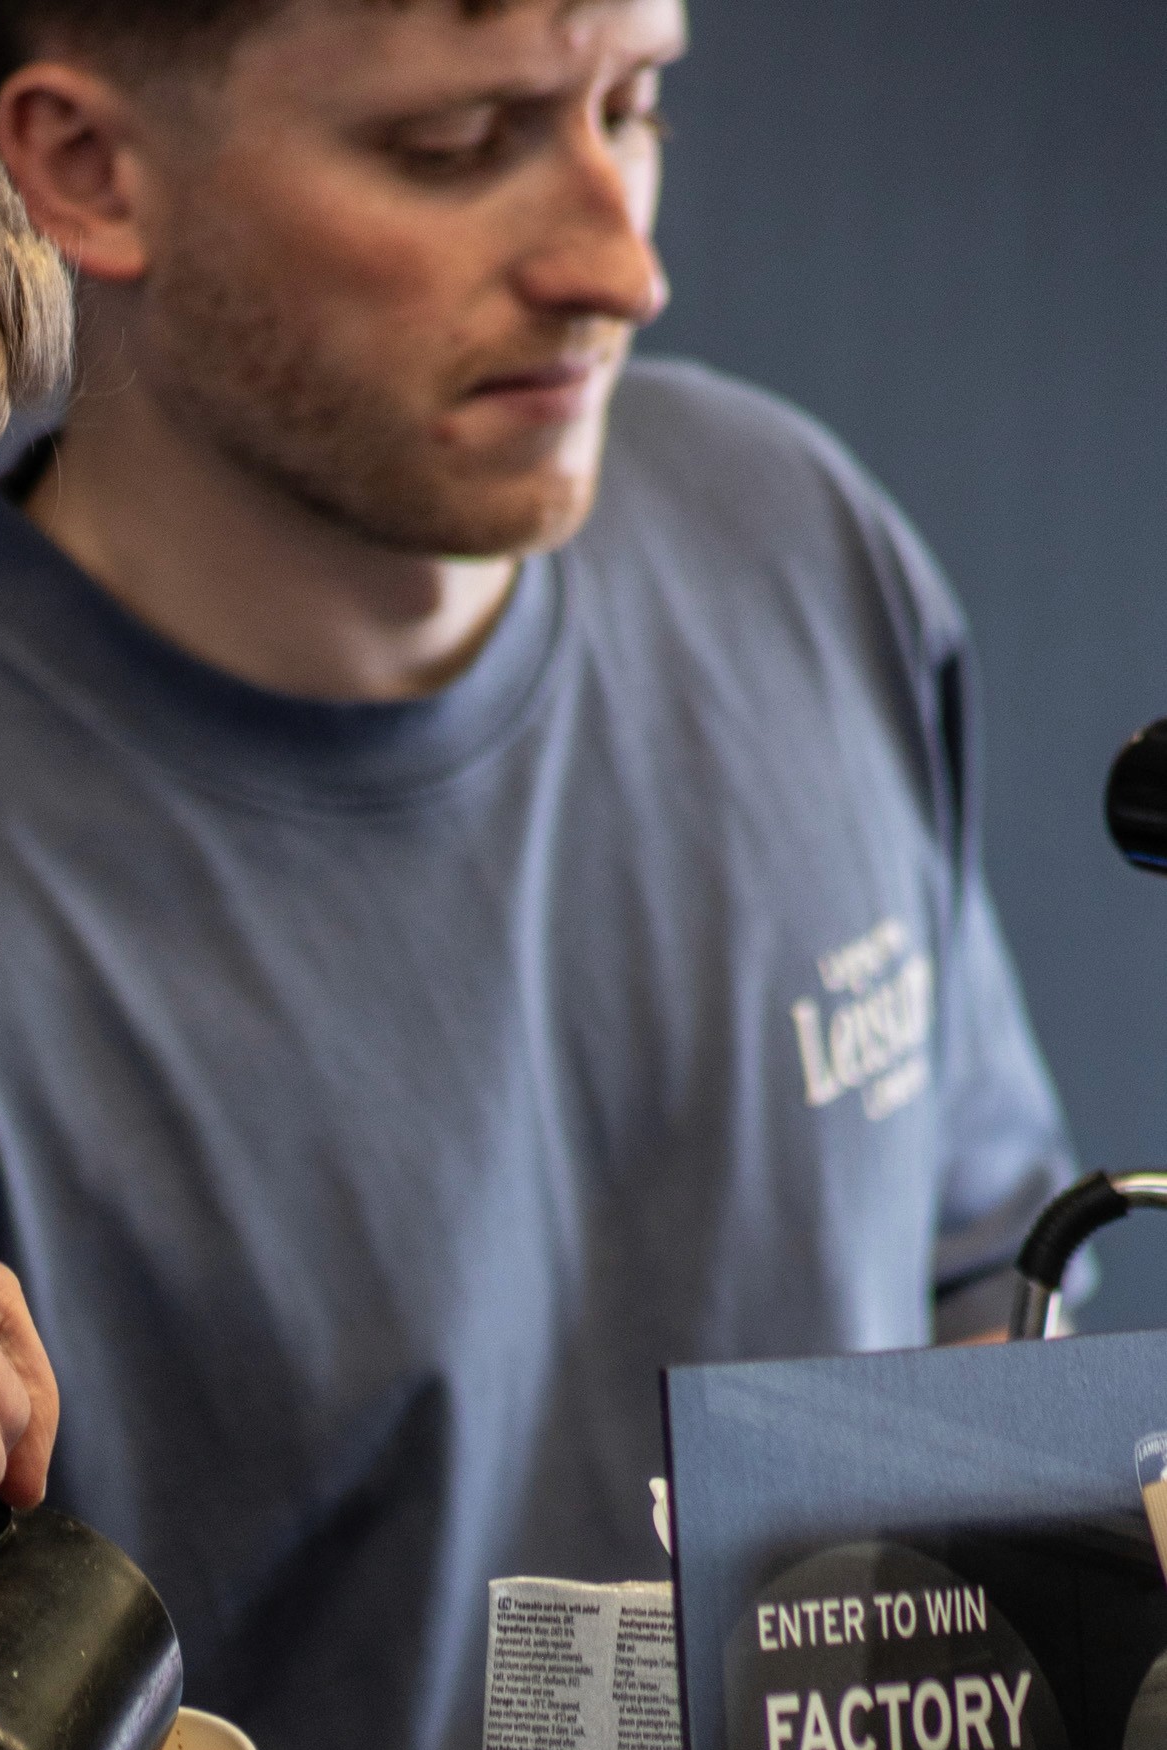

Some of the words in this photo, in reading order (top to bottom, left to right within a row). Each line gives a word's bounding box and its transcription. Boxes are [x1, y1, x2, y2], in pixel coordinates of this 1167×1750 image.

[757, 1599, 867, 1651] ENTER
[873, 1592, 917, 1641] TO
[924, 1586, 988, 1636] WIN
